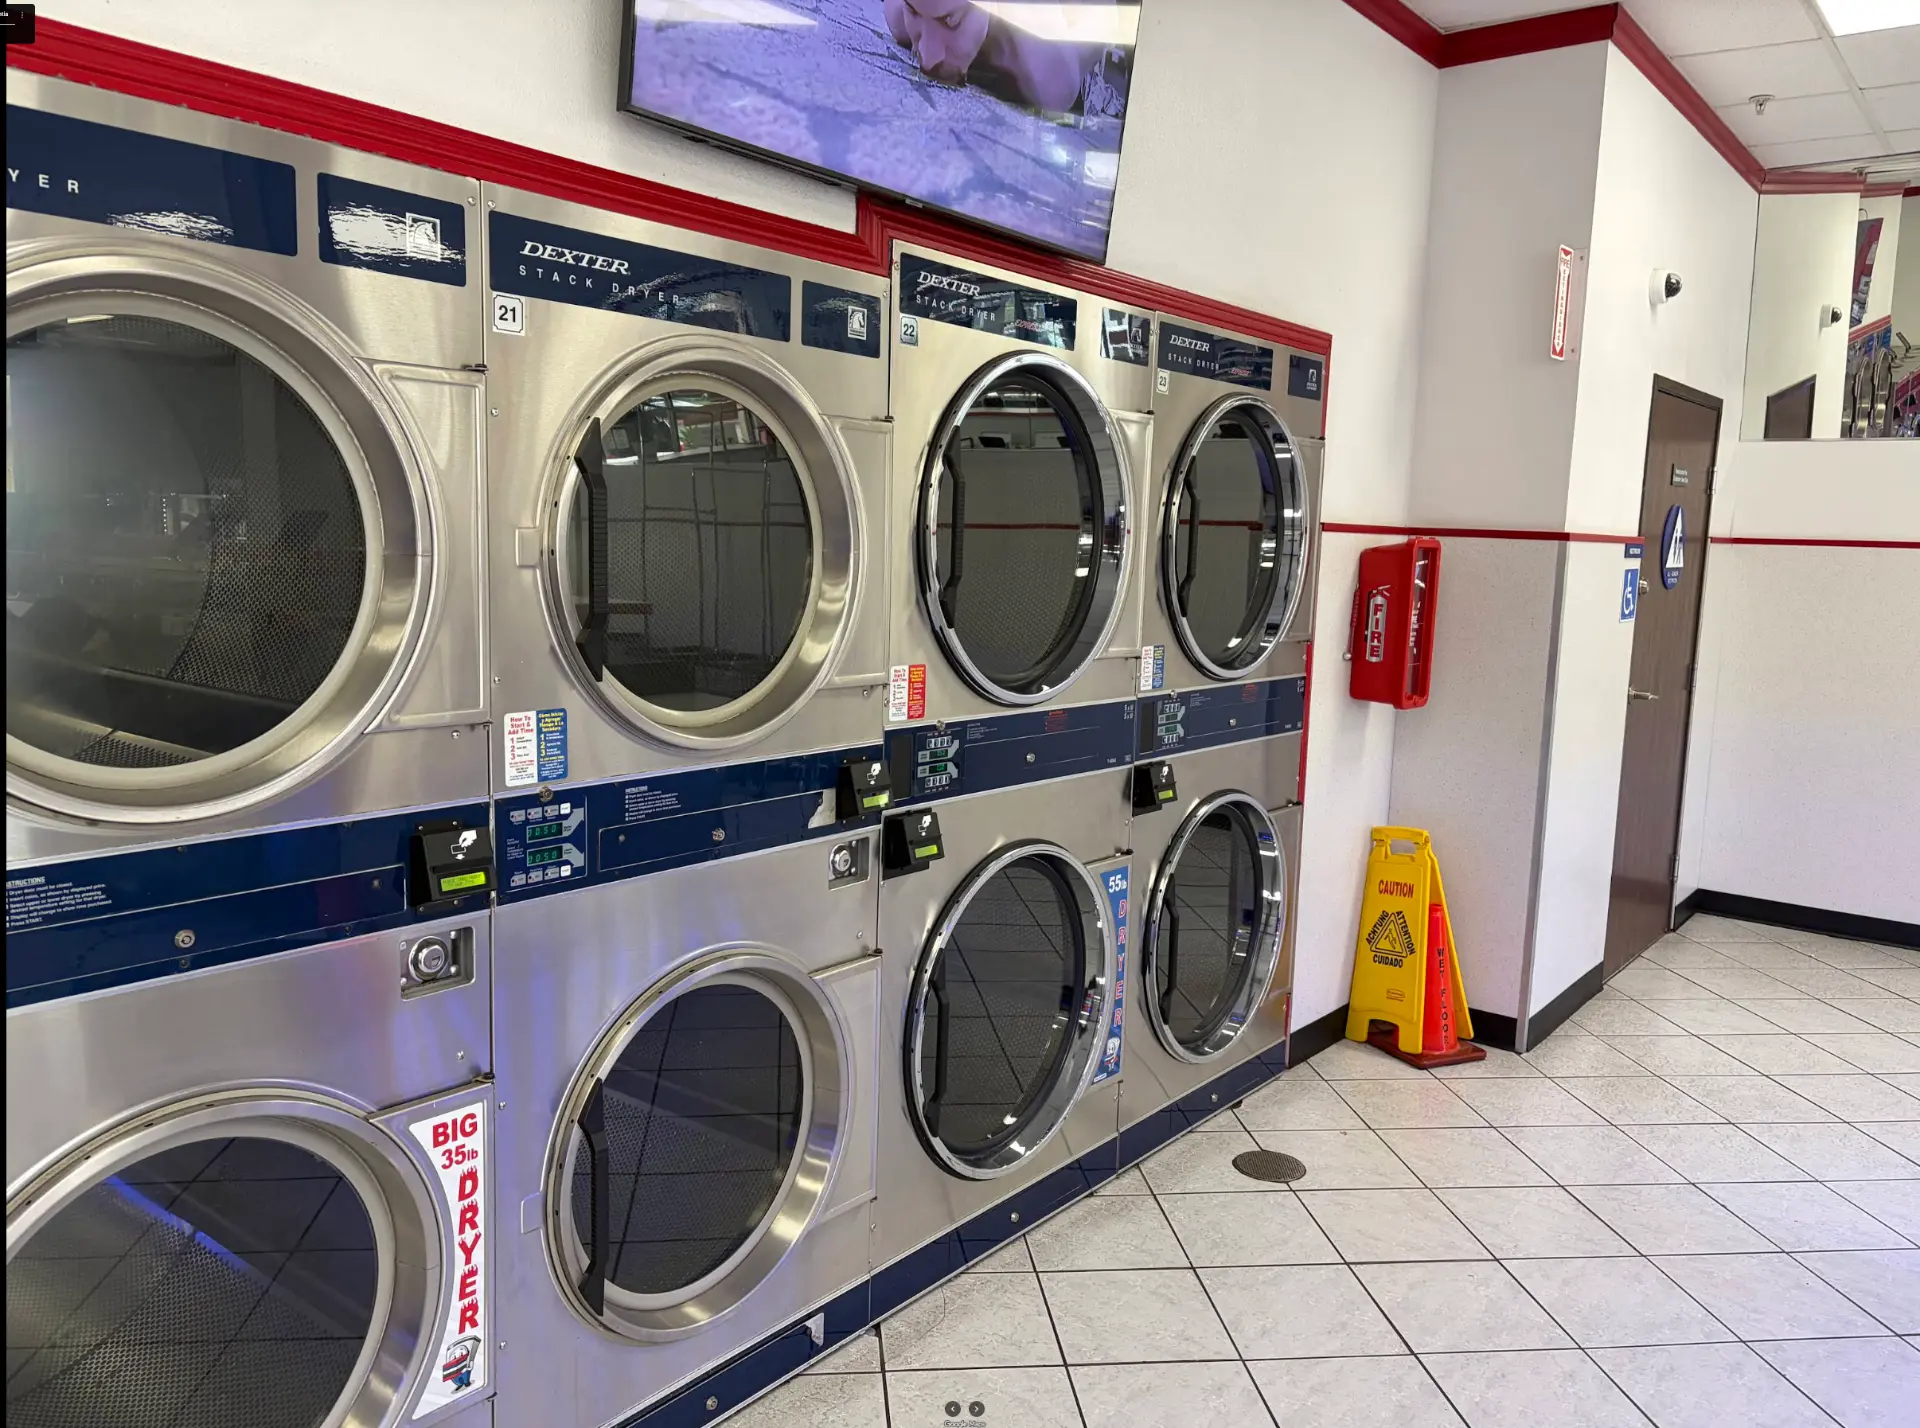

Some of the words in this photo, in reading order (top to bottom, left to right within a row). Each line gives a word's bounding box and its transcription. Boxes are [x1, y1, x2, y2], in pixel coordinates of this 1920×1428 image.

[8, 168, 79, 193] YER
[519, 240, 629, 275] DEXTER
[519, 265, 592, 288] STACK
[612, 282, 679, 304] DRYER
[917, 271, 980, 296] DEXTER
[498, 305, 516, 322] 21
[916, 294, 954, 311] STACK
[961, 306, 996, 321] DRYER
[903, 324, 915, 337] 22
[1169, 334, 1210, 352] DEXTER
[1168, 352, 1192, 365] STACK
[1196, 359, 1220, 371] DRYER
[1159, 376, 1167, 387] 23
[1370, 603, 1384, 658] FIRE
[1378, 879, 1415, 899] CAUTION
[1366, 910, 1389, 946] ACHTUNG
[1396, 910, 1416, 956] ATTENTION
[1114, 899, 1127, 1027] DRYER
[1373, 954, 1403, 968] CUIDADO
[432, 1112, 478, 1149] BIG
[441, 1144, 479, 1170] 35lb
[458, 1165, 481, 1335] DRYER
